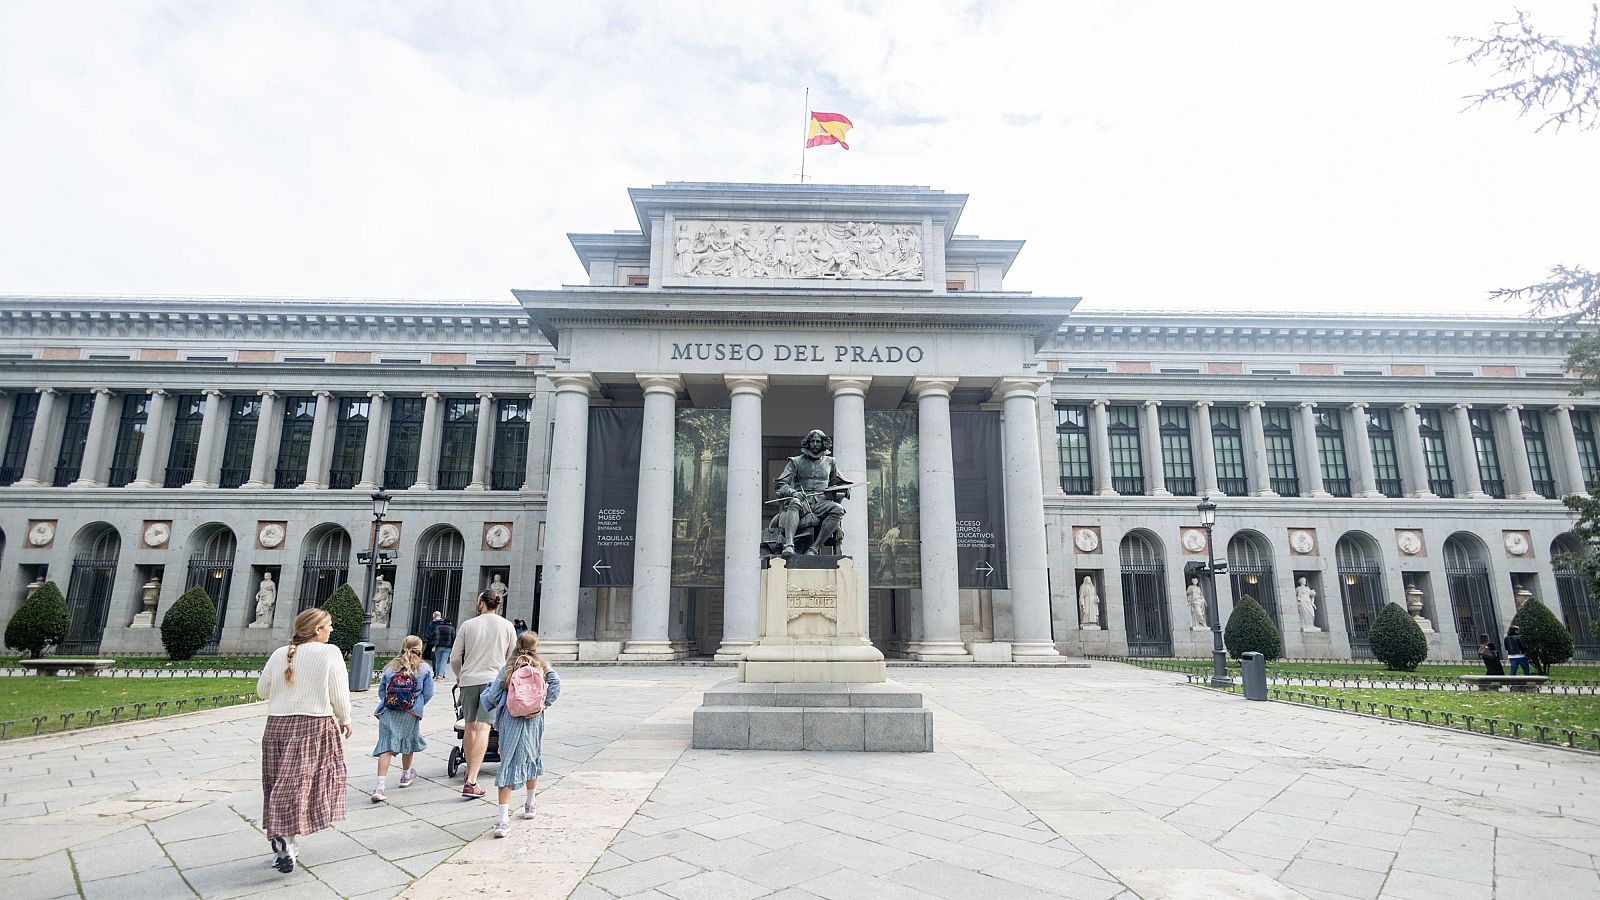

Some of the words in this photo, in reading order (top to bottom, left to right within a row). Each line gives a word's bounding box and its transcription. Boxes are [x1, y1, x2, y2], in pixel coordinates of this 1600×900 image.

[670, 343, 764, 361] MUSEO
[774, 344, 825, 362] DEL
[834, 345, 924, 363] PRADO
